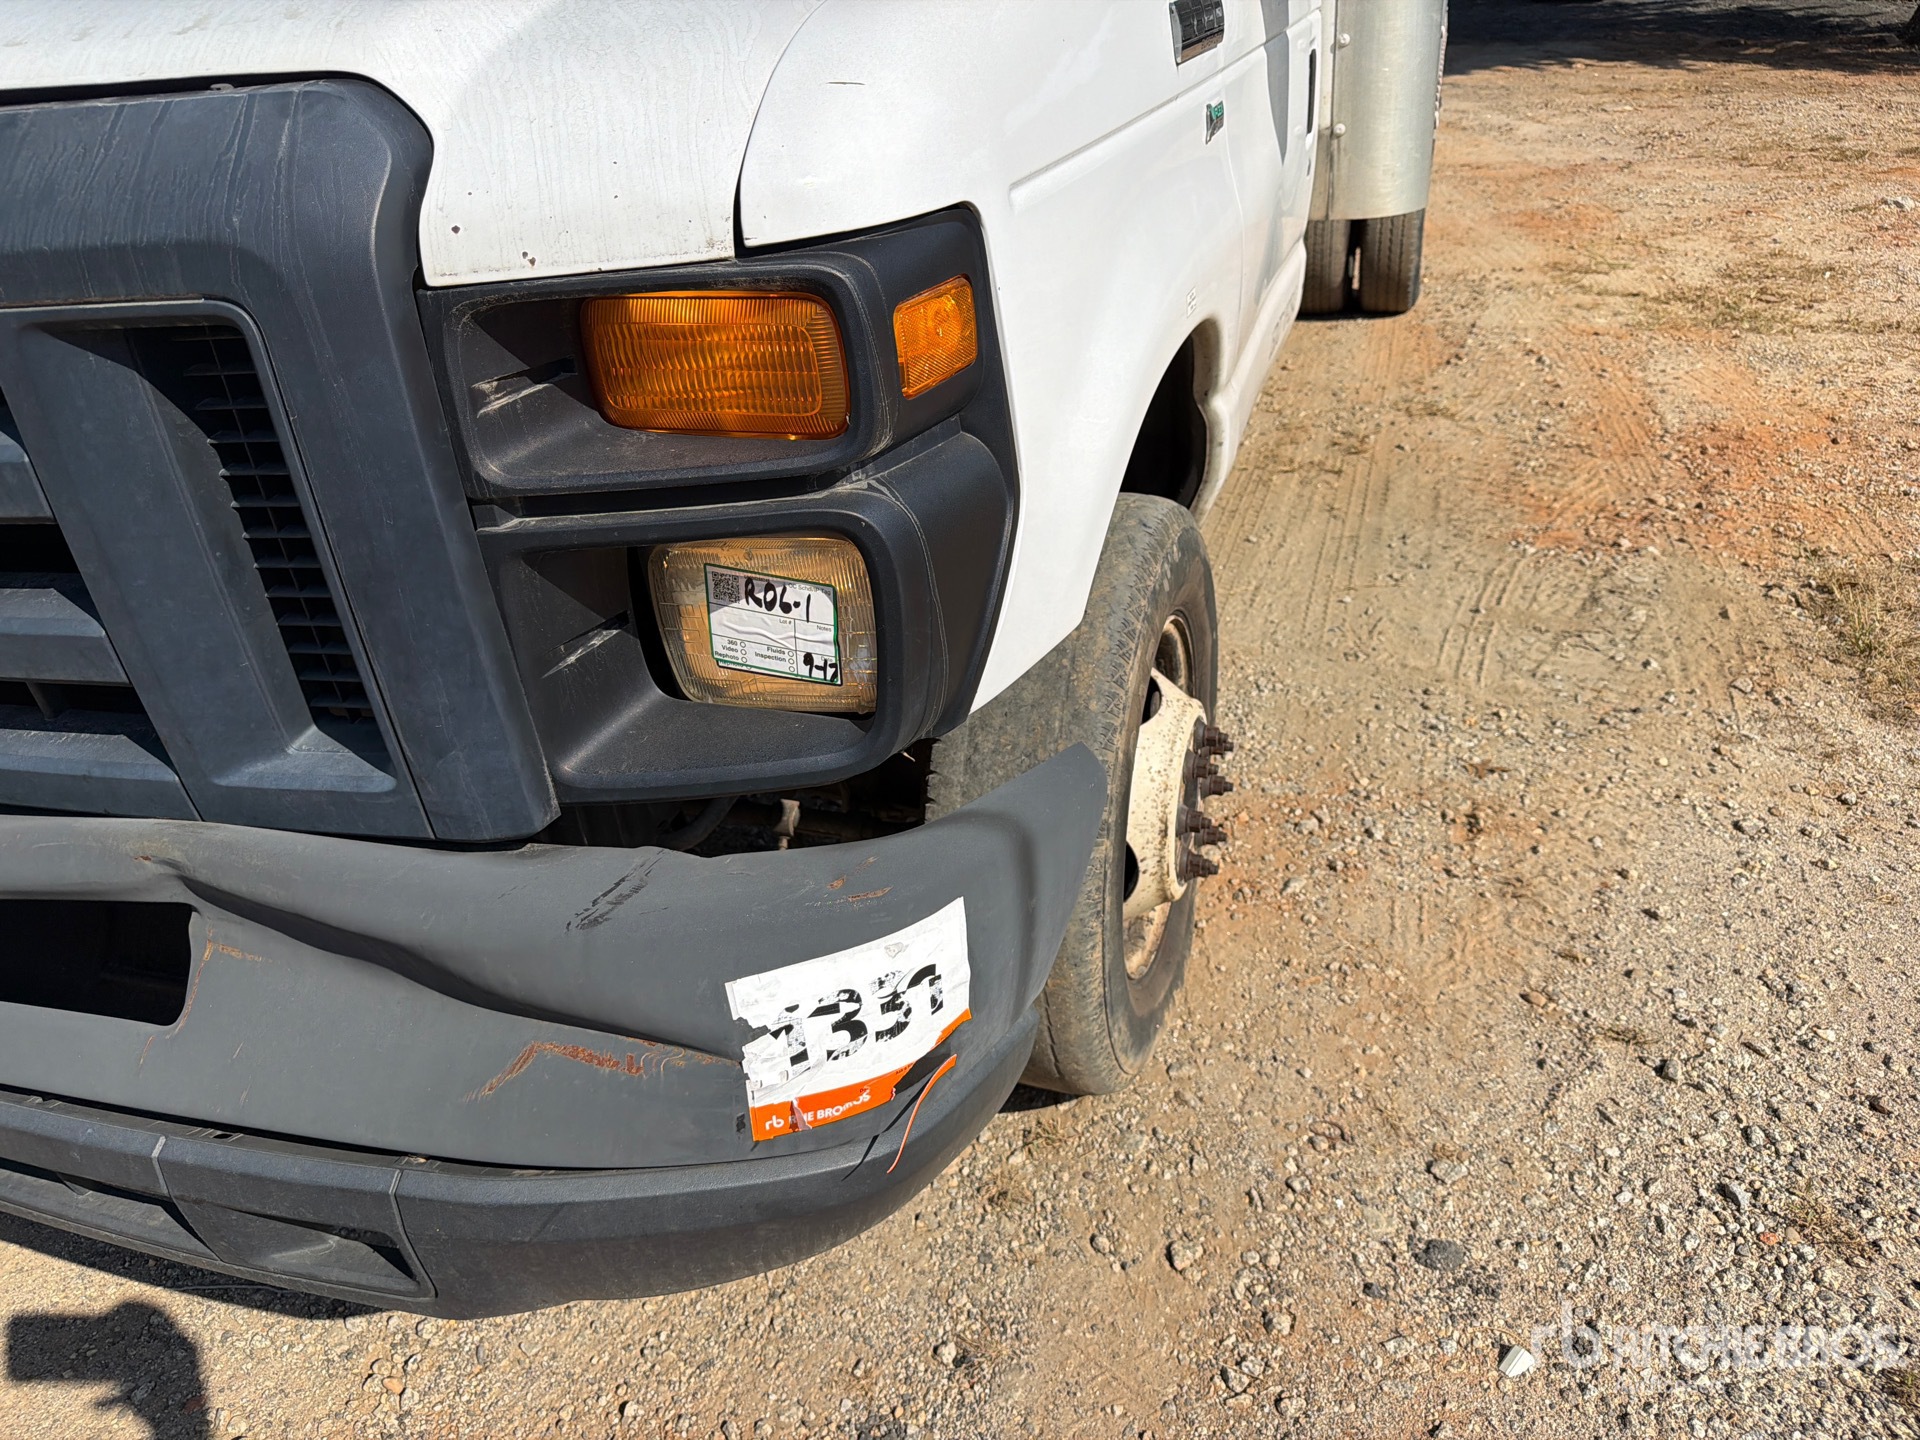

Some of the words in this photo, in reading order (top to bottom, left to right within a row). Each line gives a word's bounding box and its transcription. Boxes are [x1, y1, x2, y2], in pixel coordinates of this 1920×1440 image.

[816, 624, 832, 632] Notes
[727, 639, 738, 647] 360
[721, 644, 739, 653] Video
[766, 646, 786, 656] Fluids
[714, 650, 740, 661] Rephoto
[754, 651, 787, 663] Inspection
